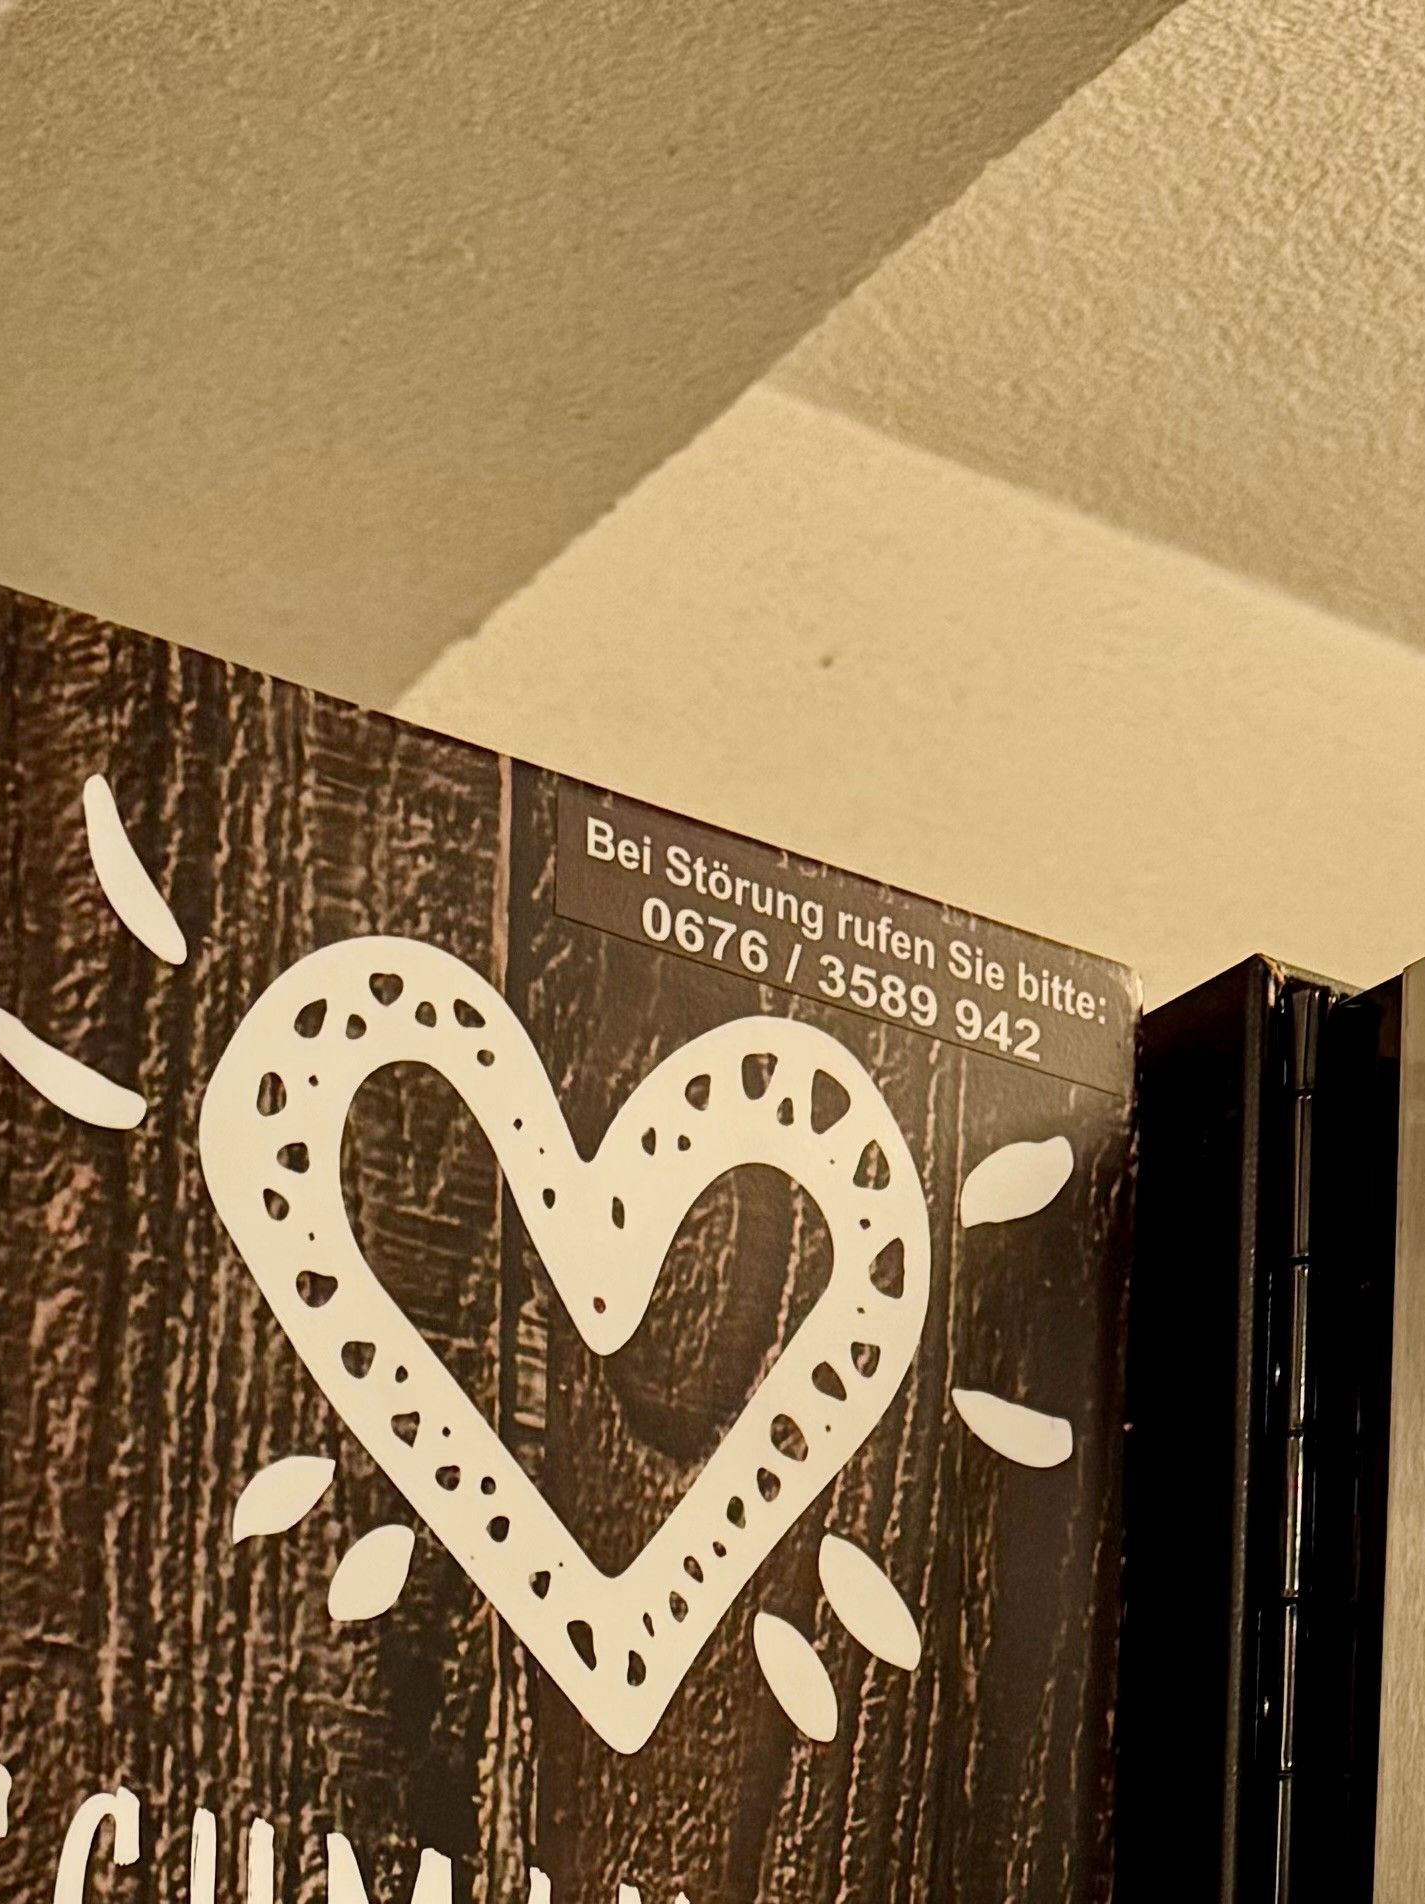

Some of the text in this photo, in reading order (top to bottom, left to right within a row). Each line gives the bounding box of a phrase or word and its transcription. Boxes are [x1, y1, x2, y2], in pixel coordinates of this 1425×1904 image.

[587, 816, 1107, 1024] Bei Störung rufen Sie bitte:
[642, 897, 1042, 1062] 0676 / 3589 942
